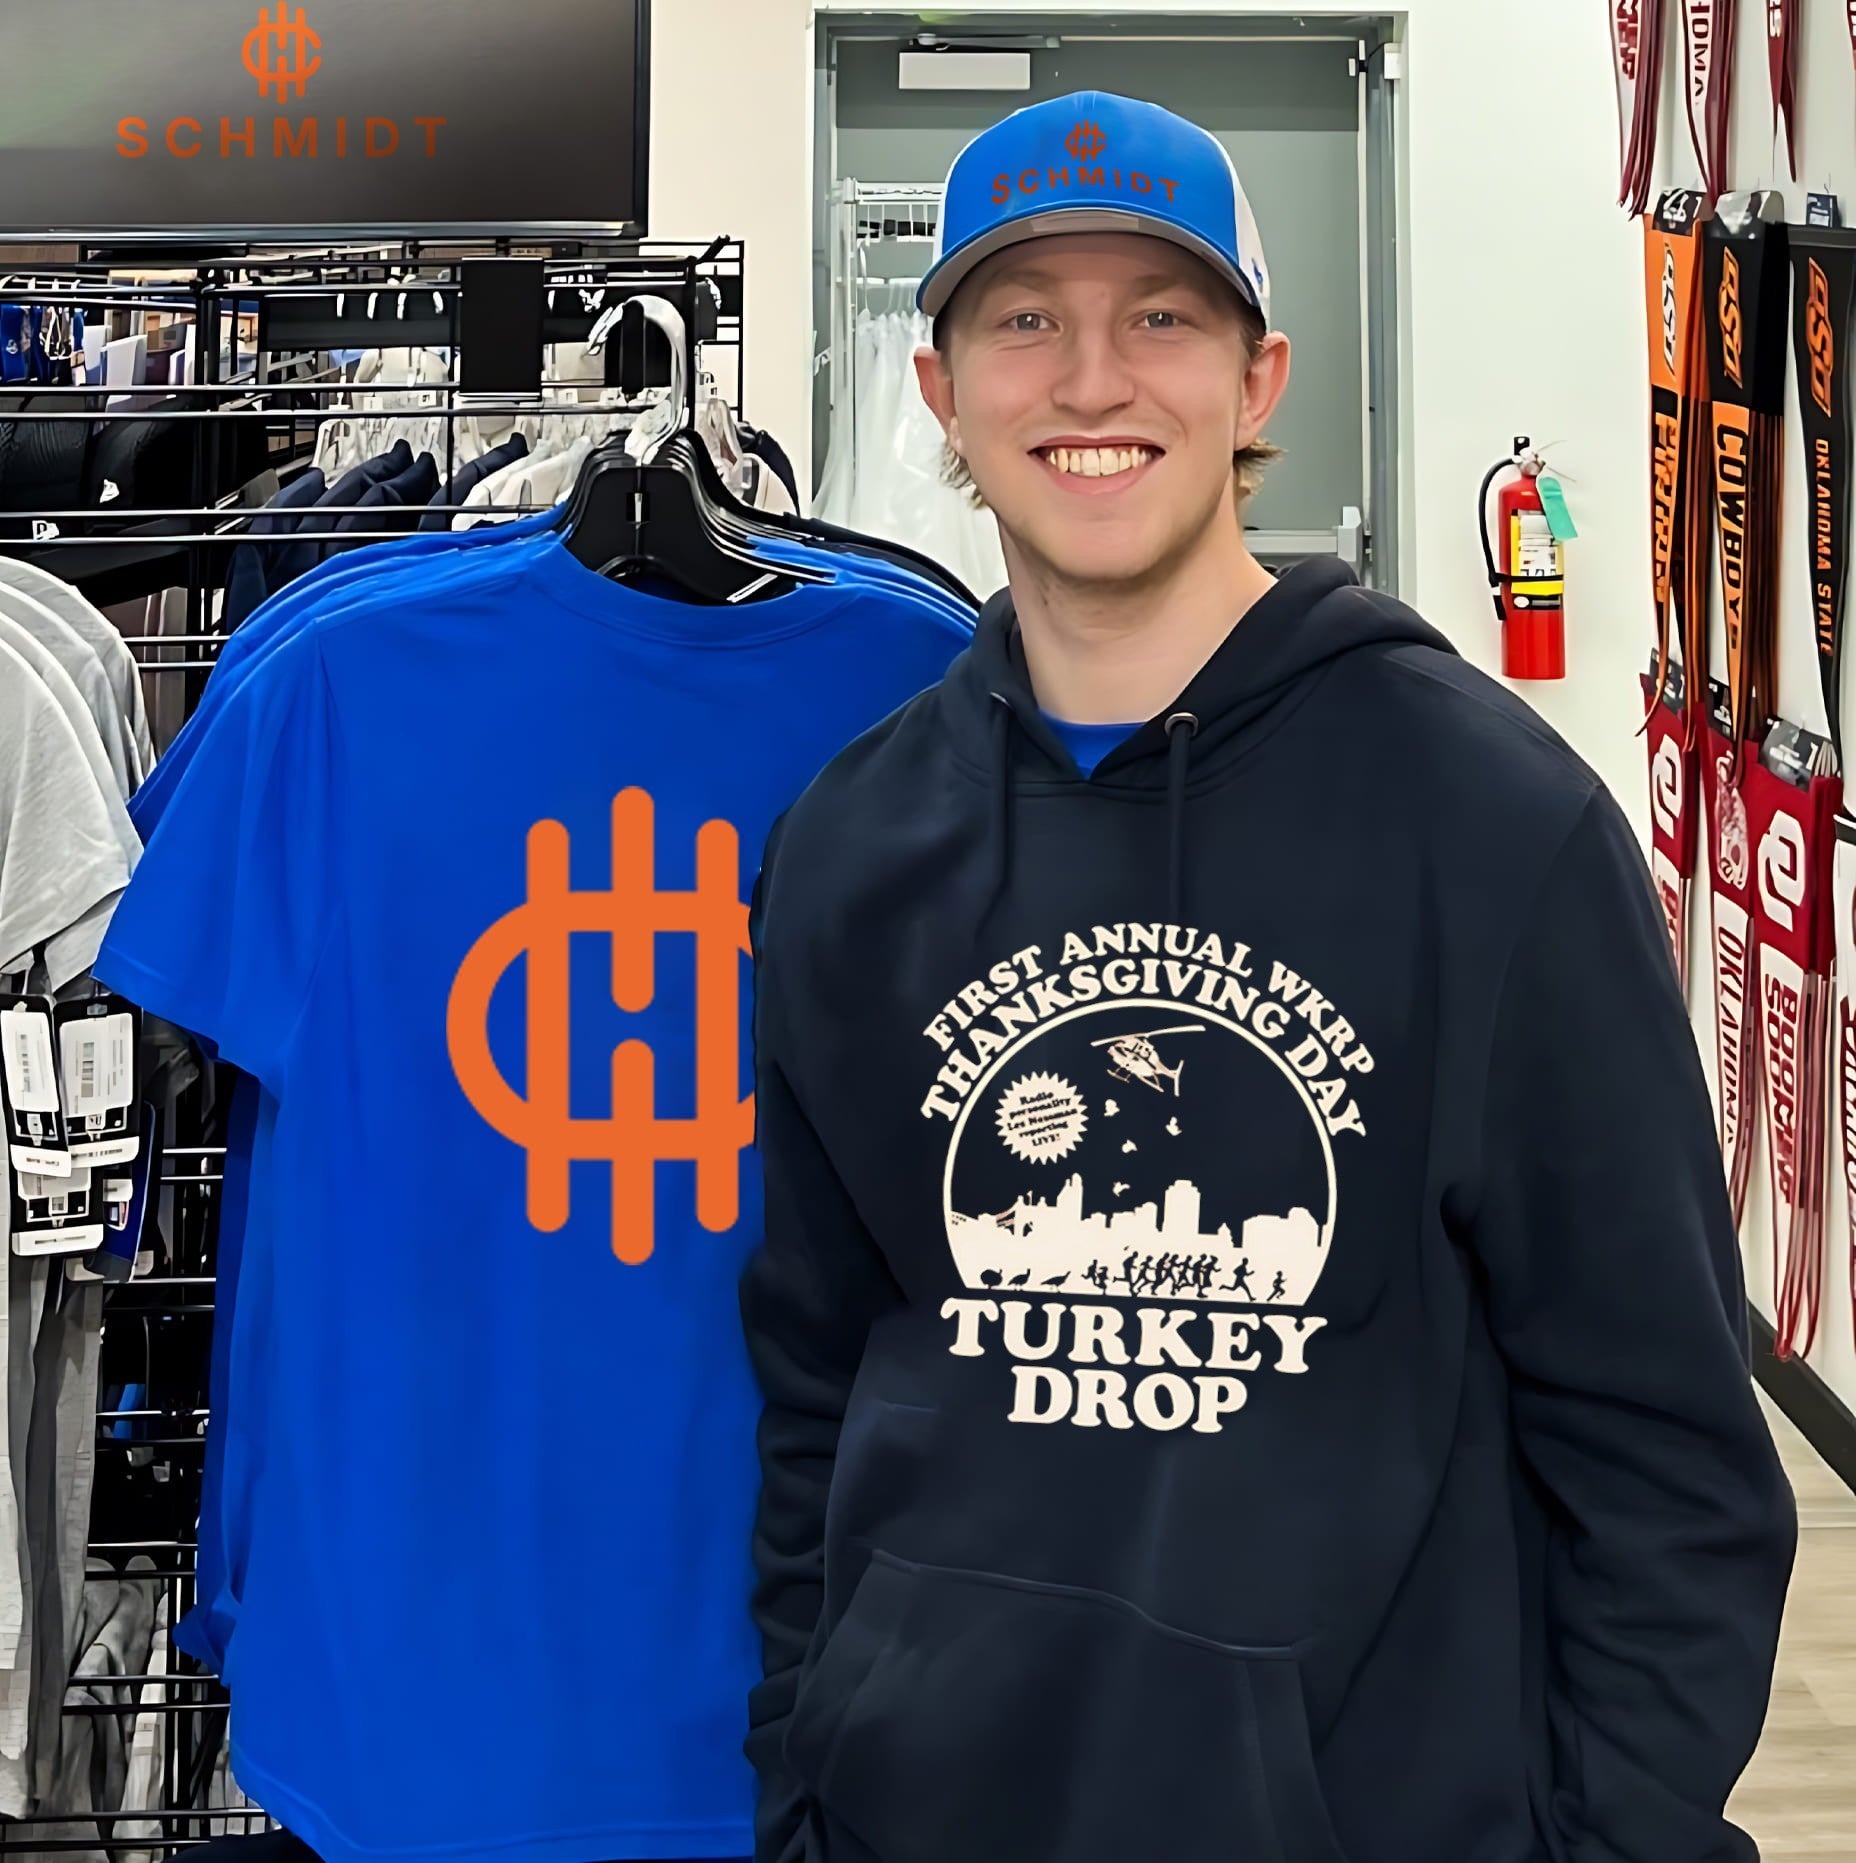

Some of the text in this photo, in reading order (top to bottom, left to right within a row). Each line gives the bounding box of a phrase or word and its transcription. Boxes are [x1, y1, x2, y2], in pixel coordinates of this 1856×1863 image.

[115, 117, 447, 158] SCHMIDT
[991, 167, 1178, 204] SCHMIDT
[1815, 438, 1832, 570] OKLAHOMA
[923, 923, 1376, 1076] FIRST ANNUAL WKRP
[920, 958, 1367, 1137] THANKSGIVING DAY
[940, 1297, 1328, 1374] TURKEY
[1007, 1365, 1248, 1433] DROP
